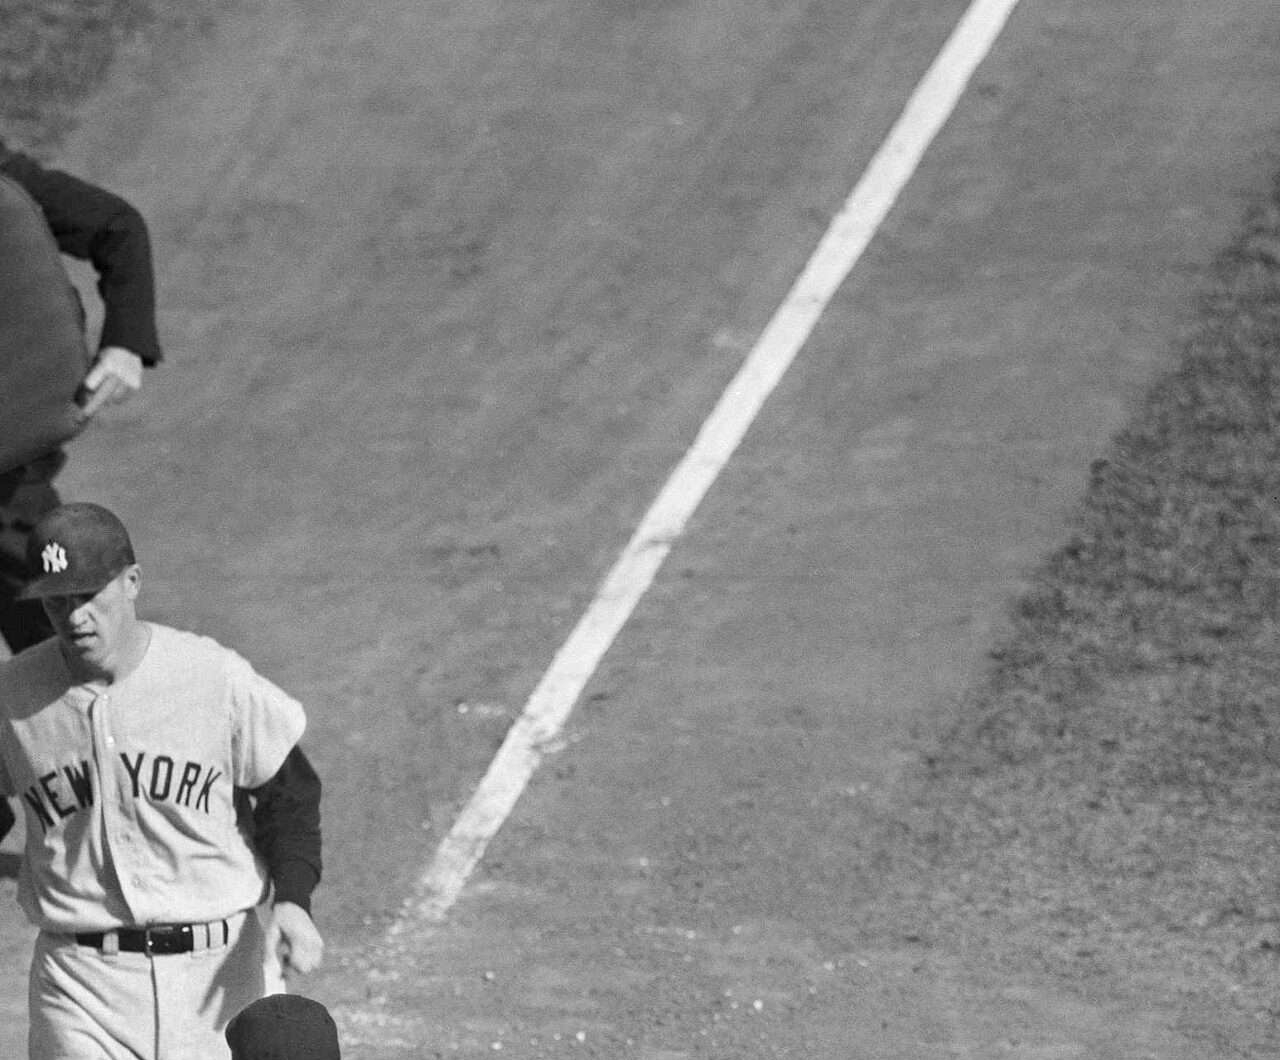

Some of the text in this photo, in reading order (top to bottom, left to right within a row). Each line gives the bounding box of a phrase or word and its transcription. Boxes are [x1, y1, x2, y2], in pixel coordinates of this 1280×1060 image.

[41, 542, 68, 573] NY
[24, 753, 222, 834] NEW YORK
